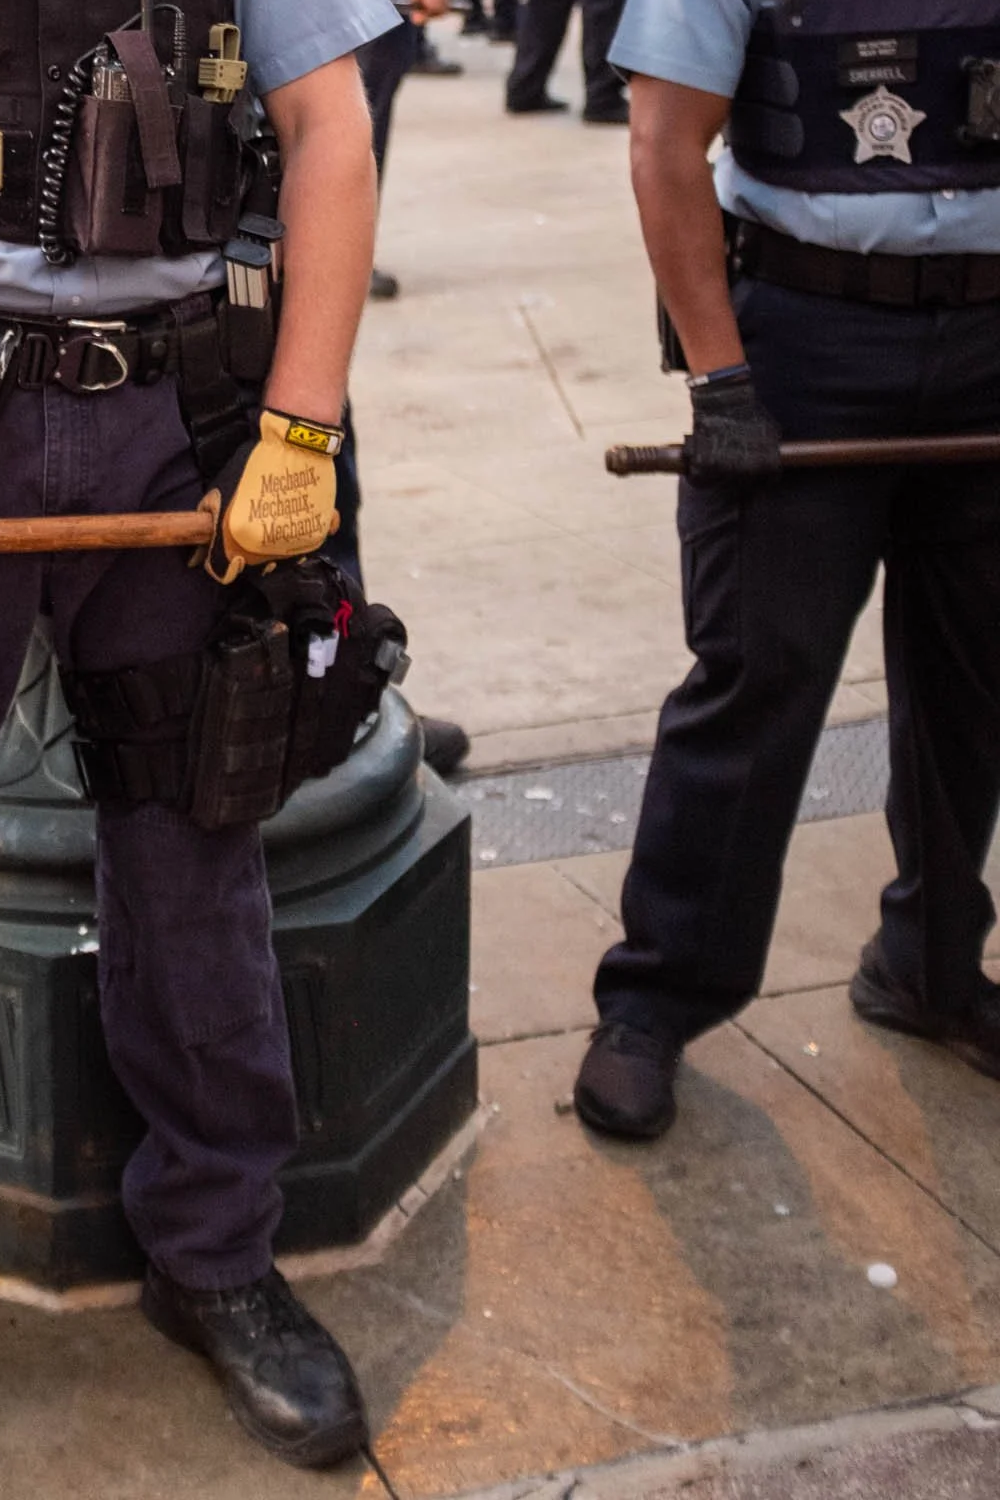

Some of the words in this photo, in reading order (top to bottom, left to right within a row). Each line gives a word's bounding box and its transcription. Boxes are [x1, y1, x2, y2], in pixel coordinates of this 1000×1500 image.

[260, 465, 318, 497] Mechanix
[248, 492, 310, 522] Mechanix
[261, 514, 323, 546] Mechanix
